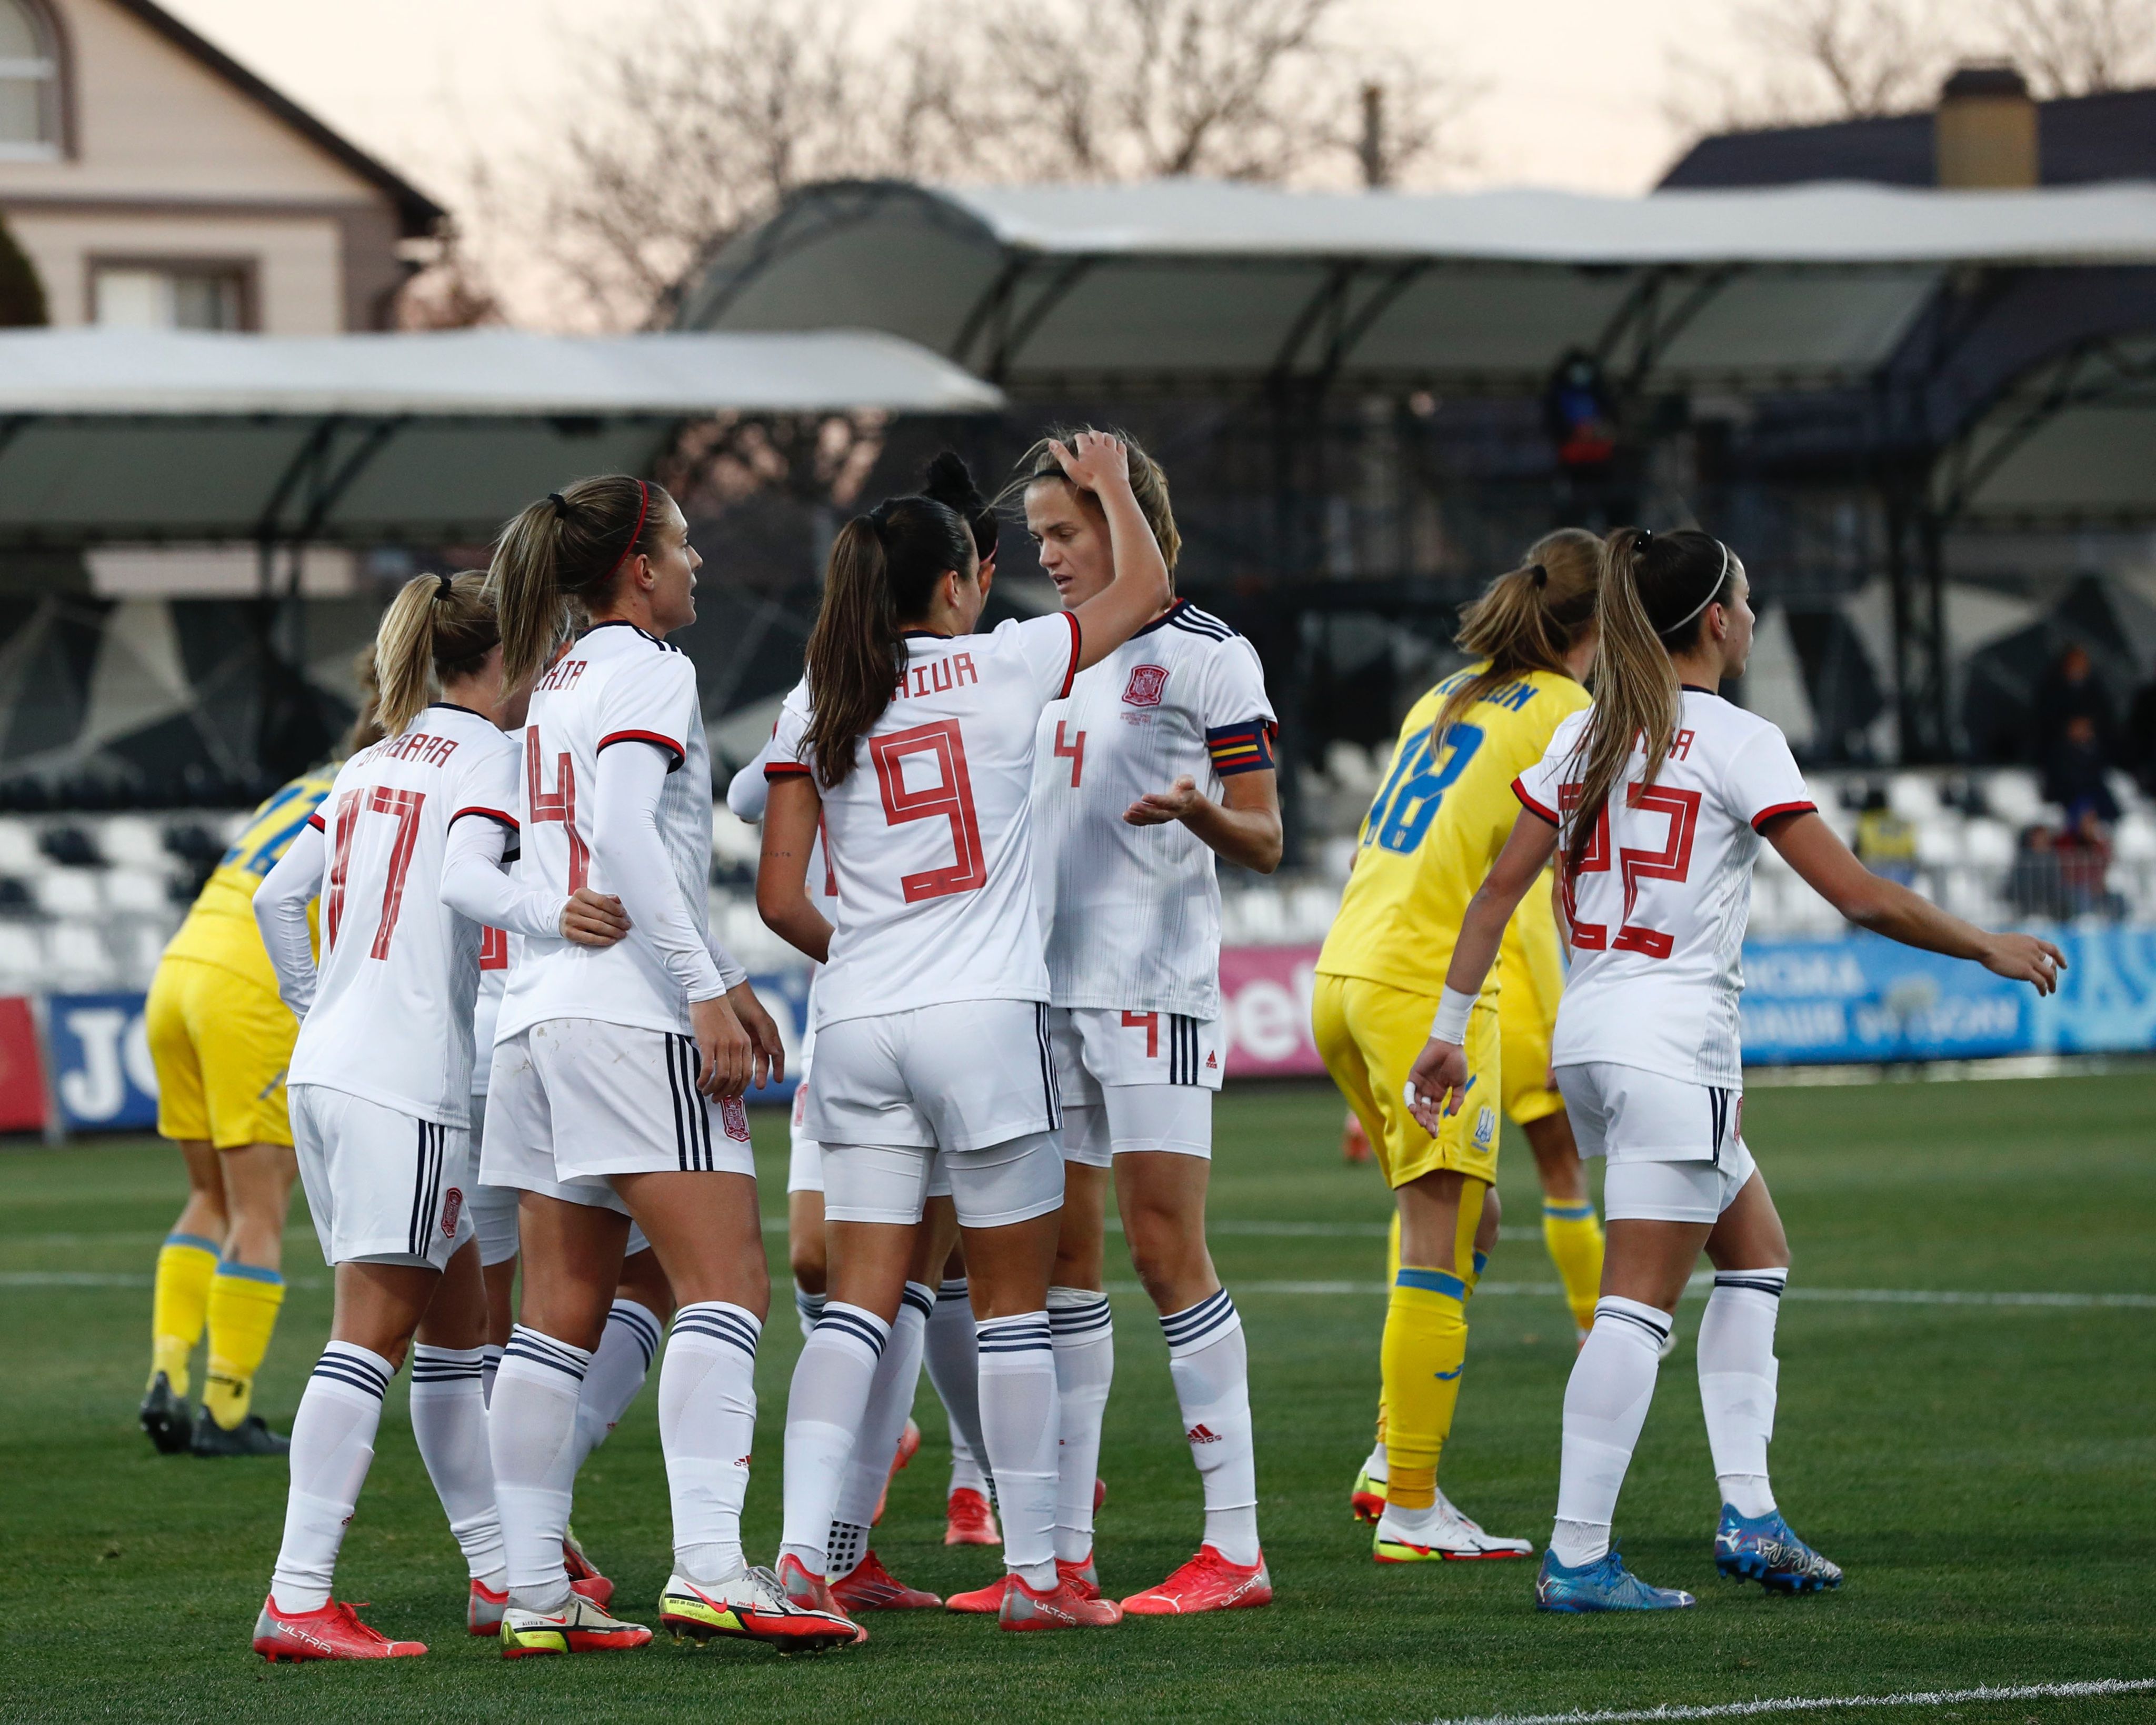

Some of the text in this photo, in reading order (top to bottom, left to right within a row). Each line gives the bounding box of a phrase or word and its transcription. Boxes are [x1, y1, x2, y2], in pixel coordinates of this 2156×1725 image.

[534, 660, 588, 693] XIA
[890, 652, 978, 702] AIUR
[1054, 720, 1086, 787] 4
[869, 719, 987, 903] 9
[1362, 721, 1485, 856] 18
[327, 785, 426, 961] 17
[1558, 782, 1702, 959] 22
[1121, 1010, 1158, 1058] 4
[1034, 1600, 1077, 1626] ULTRA
[1220, 1574, 1263, 1607] ULTRA
[277, 1621, 332, 1654] ULTRA
